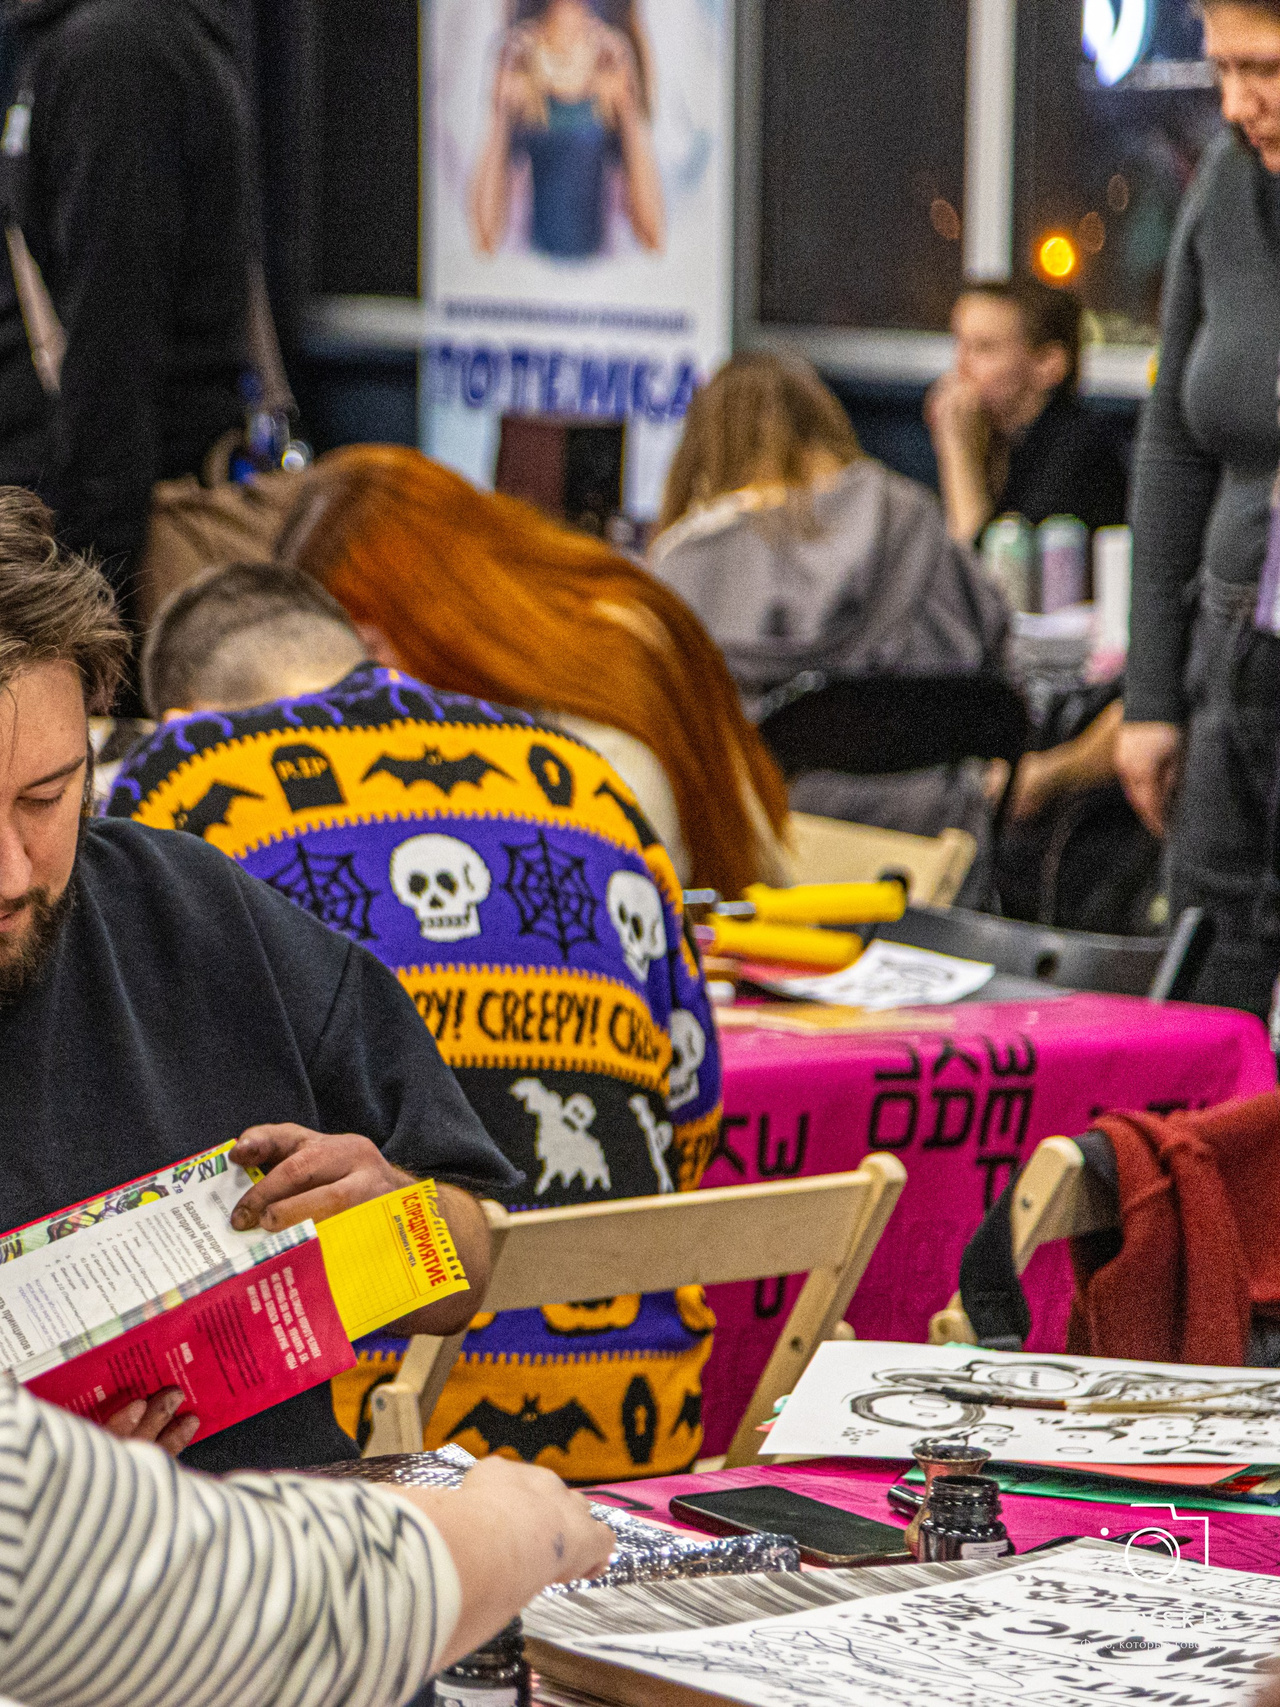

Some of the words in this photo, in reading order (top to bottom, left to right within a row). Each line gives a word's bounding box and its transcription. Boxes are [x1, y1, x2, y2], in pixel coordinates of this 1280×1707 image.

[478, 989, 602, 1048] CREEPY!
[167, 1205, 200, 1240] (алгоритм
[189, 1238, 220, 1269] Пискарё
[182, 1200, 210, 1230] Базовый
[399, 1191, 447, 1287] 1С:ПРЕДПРИЯТИЕ
[0, 1308, 32, 1351] принципов
